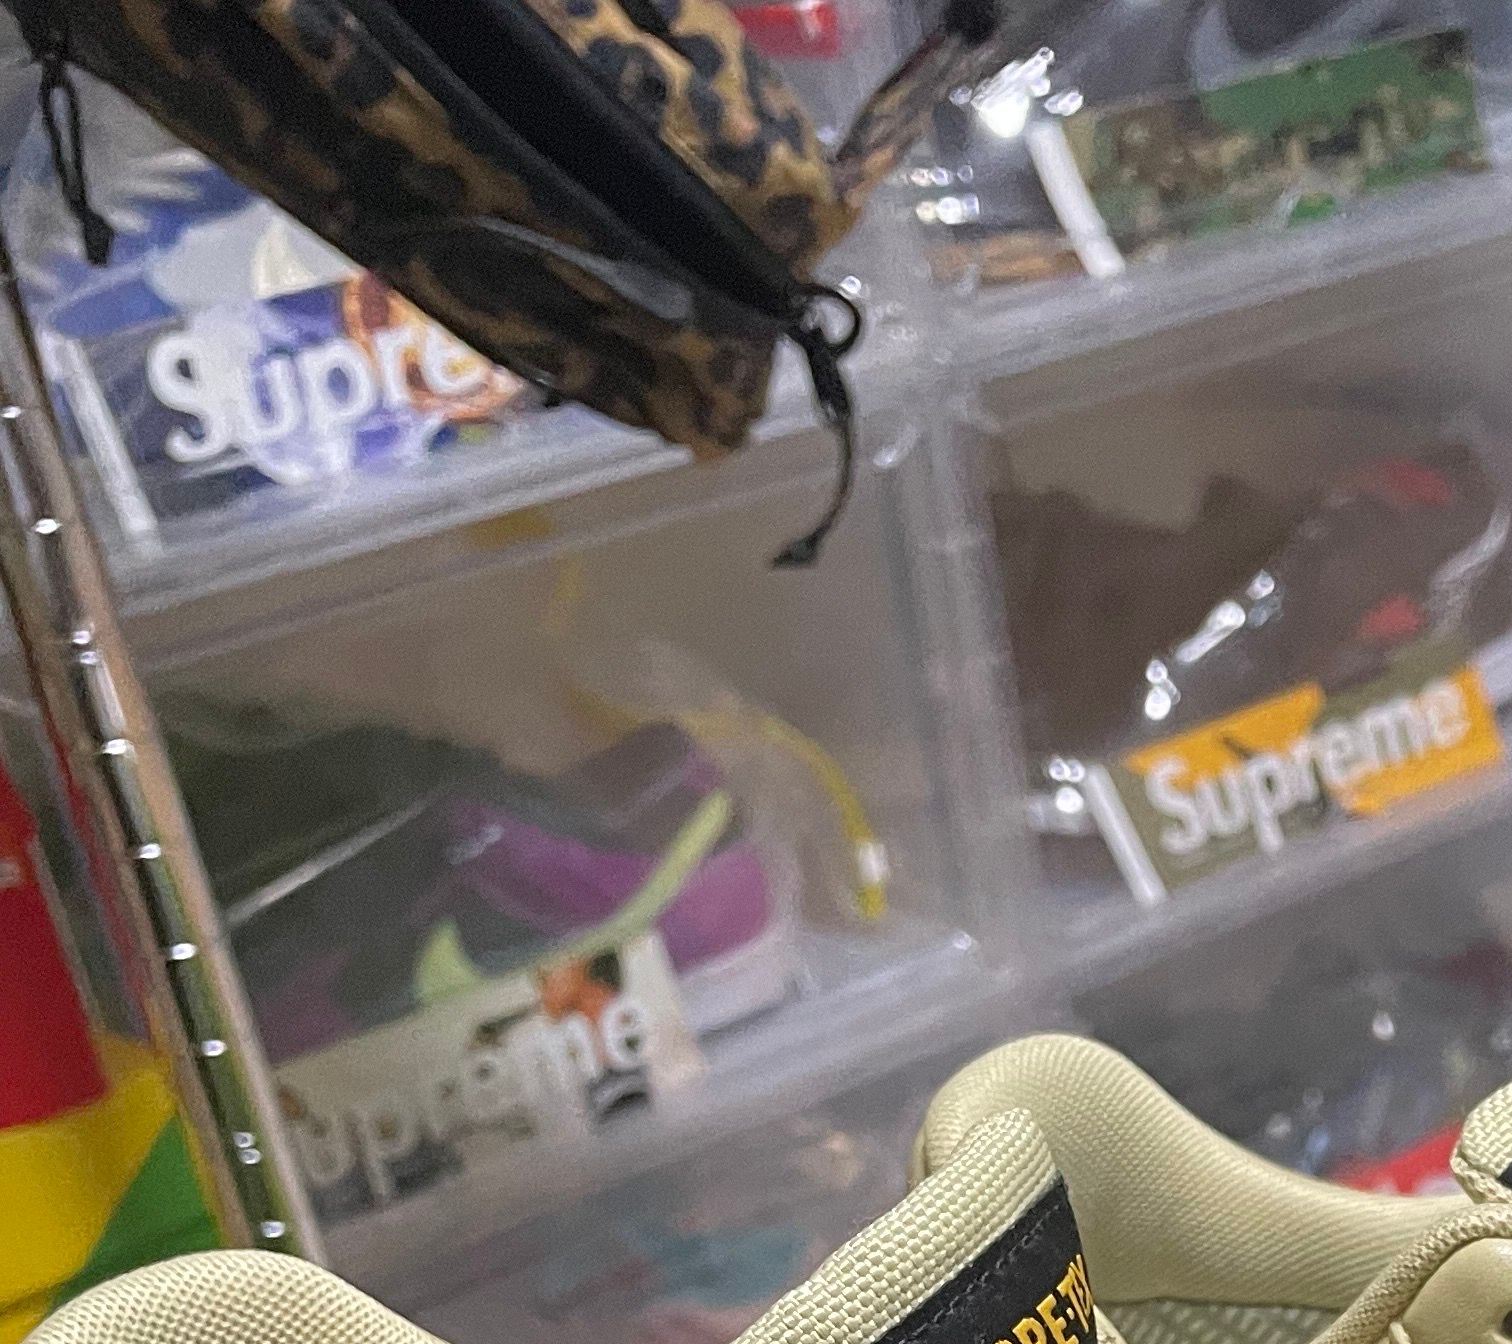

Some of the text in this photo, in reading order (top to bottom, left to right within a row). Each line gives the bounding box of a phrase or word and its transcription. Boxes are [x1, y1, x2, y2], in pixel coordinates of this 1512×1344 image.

[148, 322, 490, 477] Supre
[1146, 679, 1471, 853] Supreme
[285, 1003, 649, 1198] upreme
